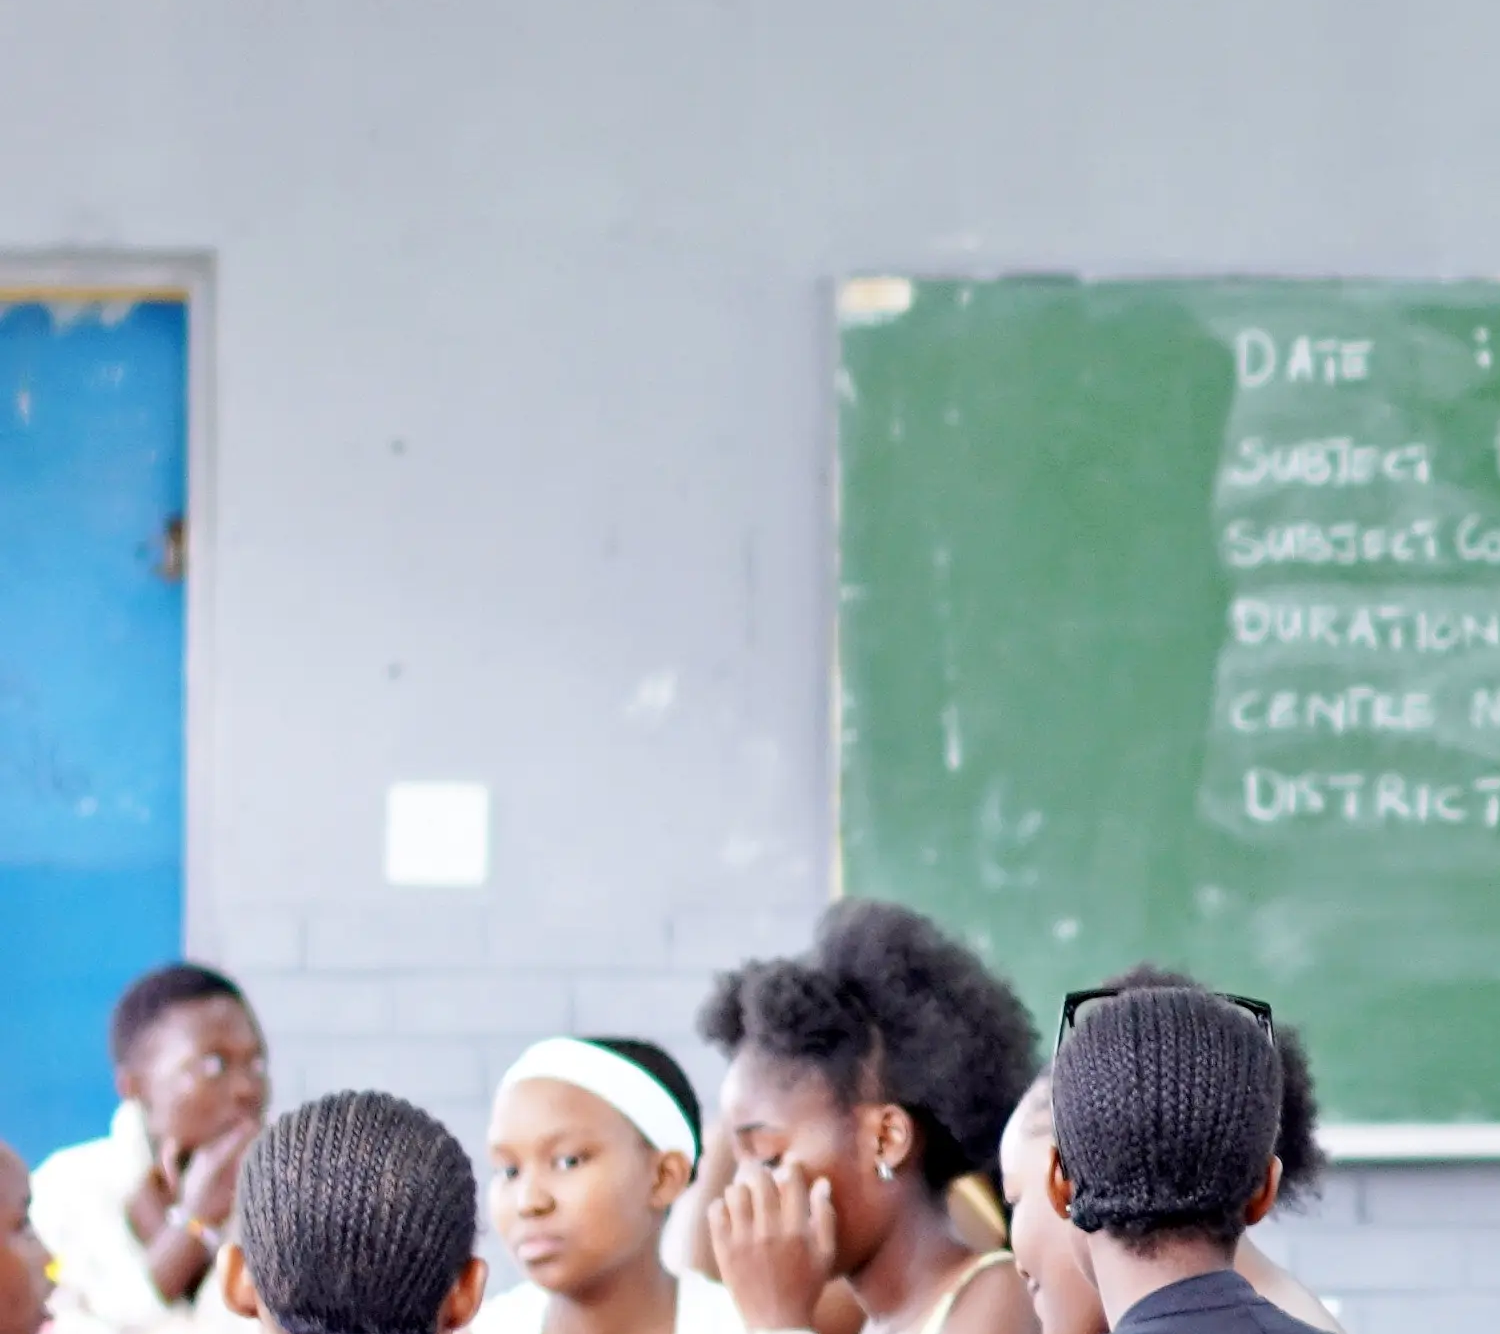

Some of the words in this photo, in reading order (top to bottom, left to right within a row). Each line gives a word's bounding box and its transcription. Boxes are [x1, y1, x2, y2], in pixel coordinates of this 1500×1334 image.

[1236, 327, 1375, 388] DATE
[1229, 437, 1433, 485] SUBJECT
[1226, 519, 1438, 567] SUBJECT
[1231, 598, 1500, 651] DURATION
[1231, 687, 1435, 735] CENTRE
